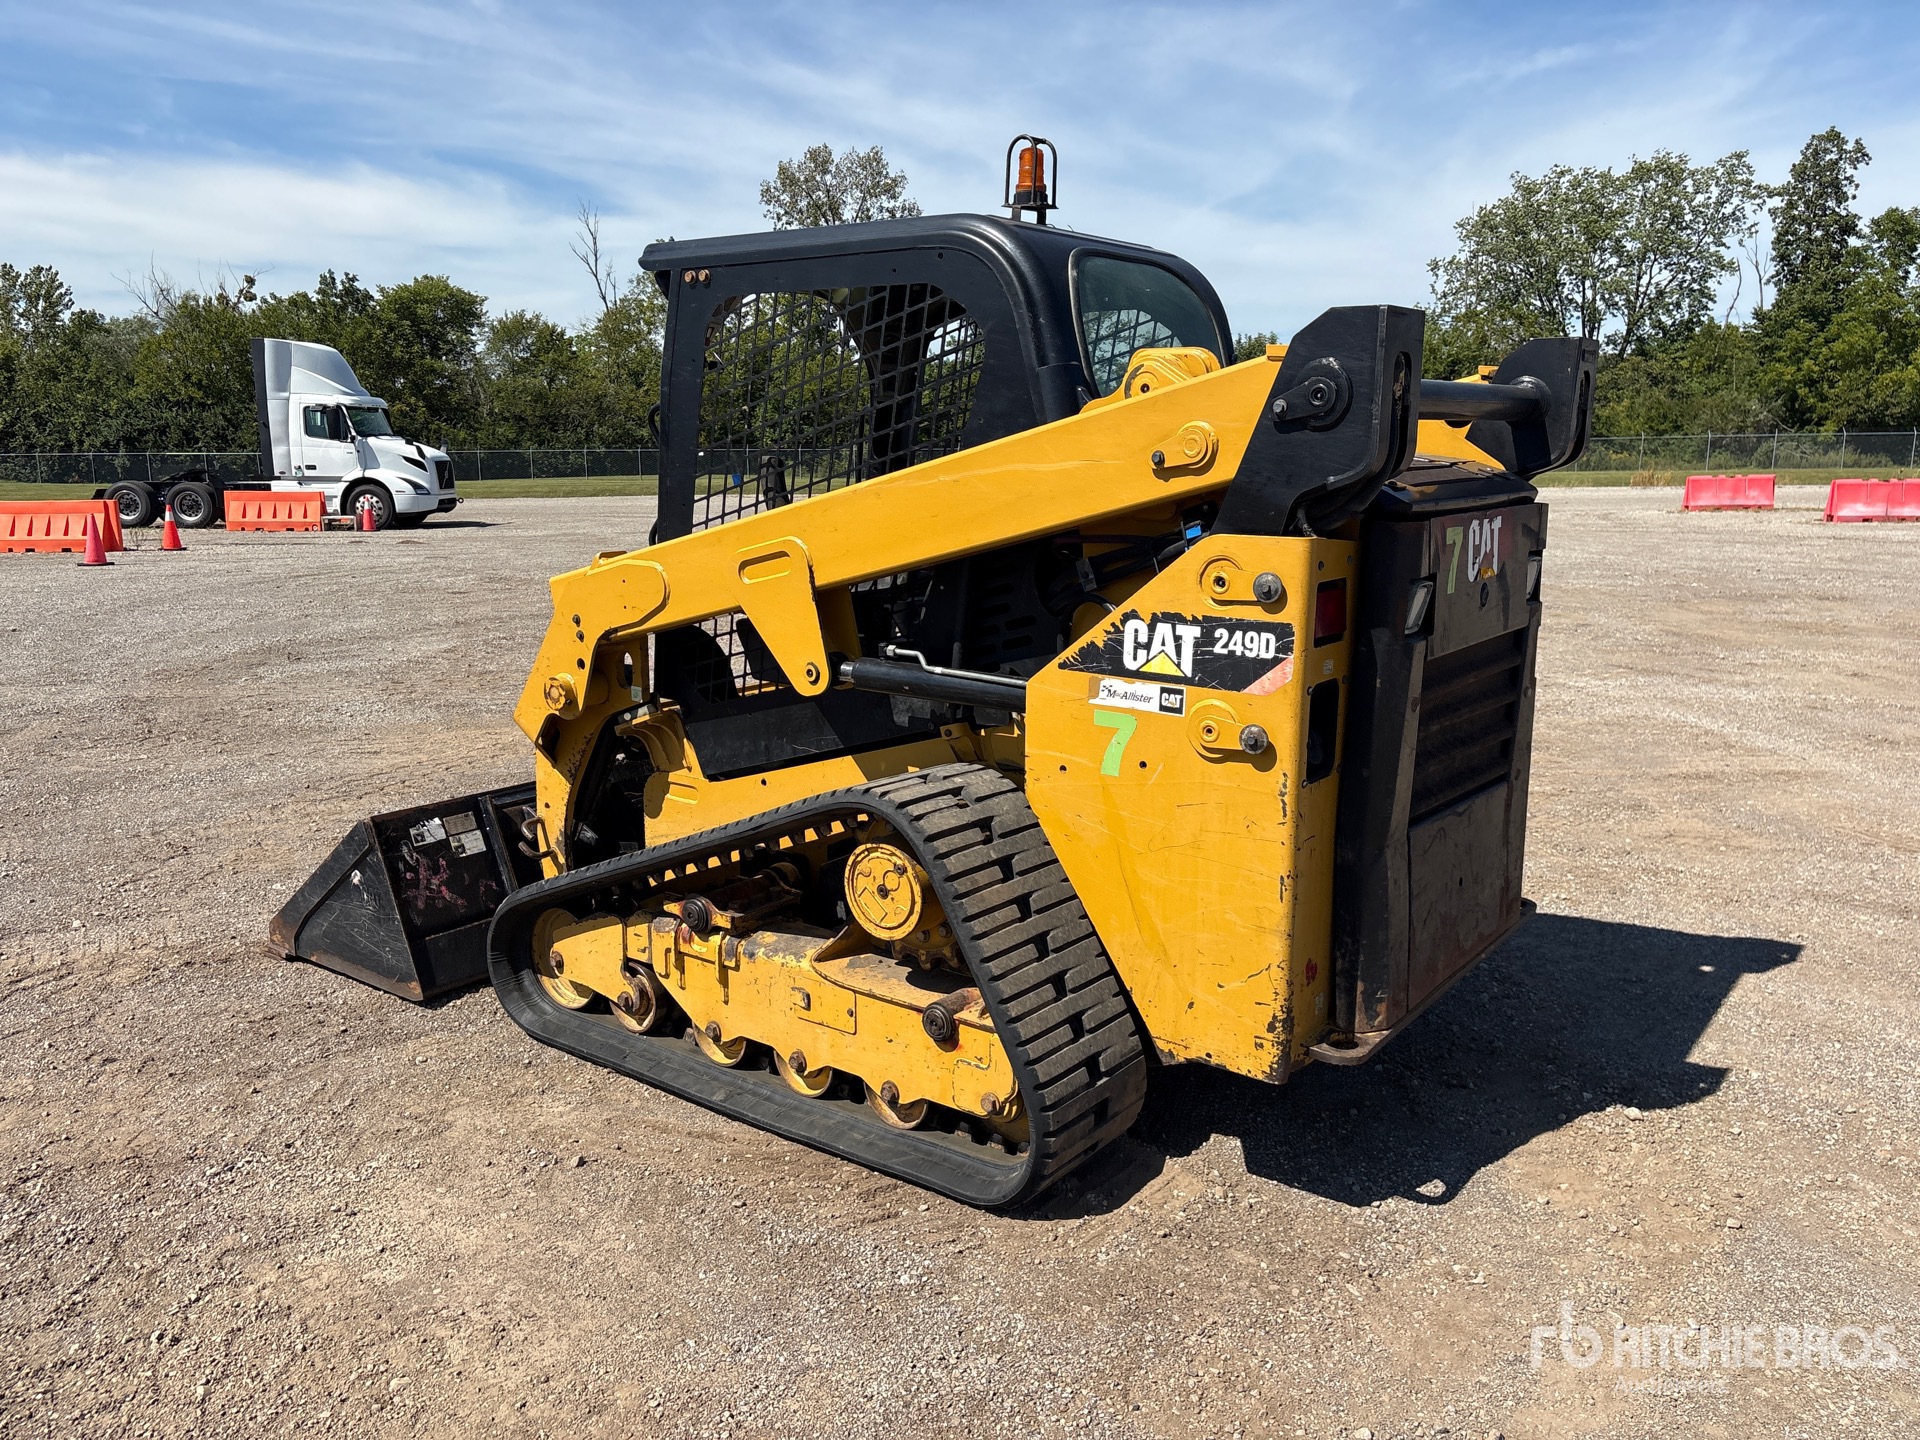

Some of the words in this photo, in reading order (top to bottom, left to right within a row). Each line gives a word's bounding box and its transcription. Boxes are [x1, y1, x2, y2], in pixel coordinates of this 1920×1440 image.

[1446, 526, 1463, 595] 7
[1467, 515, 1502, 583] CAT
[1122, 618, 1201, 678] CAT
[1213, 628, 1276, 659] 249D
[1105, 688, 1154, 704] MacAllister
[1161, 692, 1183, 708] CAT
[1093, 709, 1138, 777] 7
